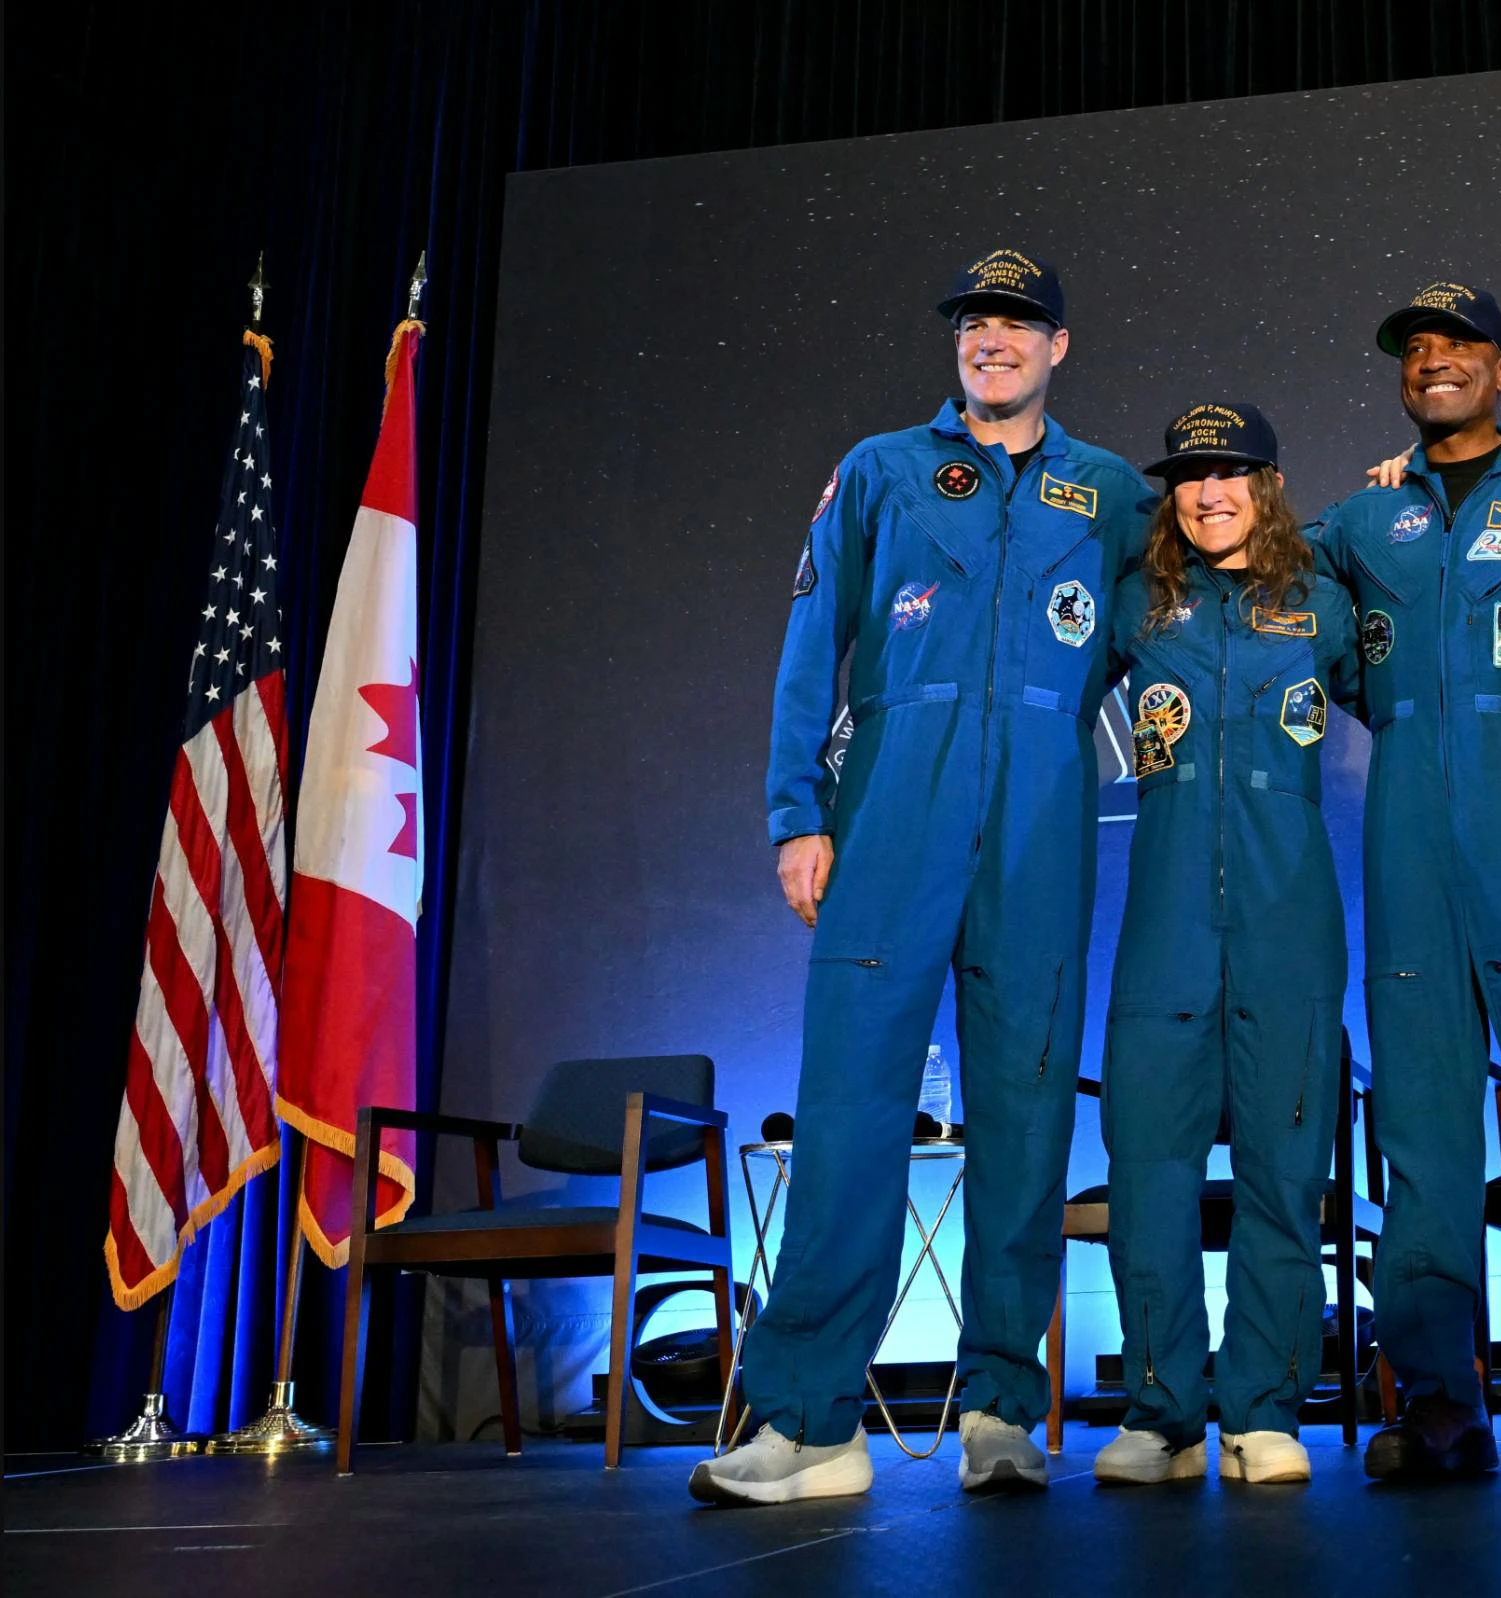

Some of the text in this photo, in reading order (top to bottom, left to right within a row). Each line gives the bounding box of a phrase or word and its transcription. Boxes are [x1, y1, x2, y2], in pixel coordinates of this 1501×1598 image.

[978, 261, 1030, 276] ASTRONAUT
[1012, 251, 1042, 278] MURTHA
[984, 269, 1021, 280] HANSEN
[975, 277, 1025, 290] ARTEMIS II
[1207, 404, 1214, 413] P.
[1214, 406, 1246, 428] MURTHA
[1181, 418, 1233, 432] ASTRONAUT
[1191, 428, 1217, 438] KOCH
[1179, 437, 1228, 450] ARTEMIS II
[1393, 517, 1429, 532] NASA
[894, 598, 931, 613] NASA
